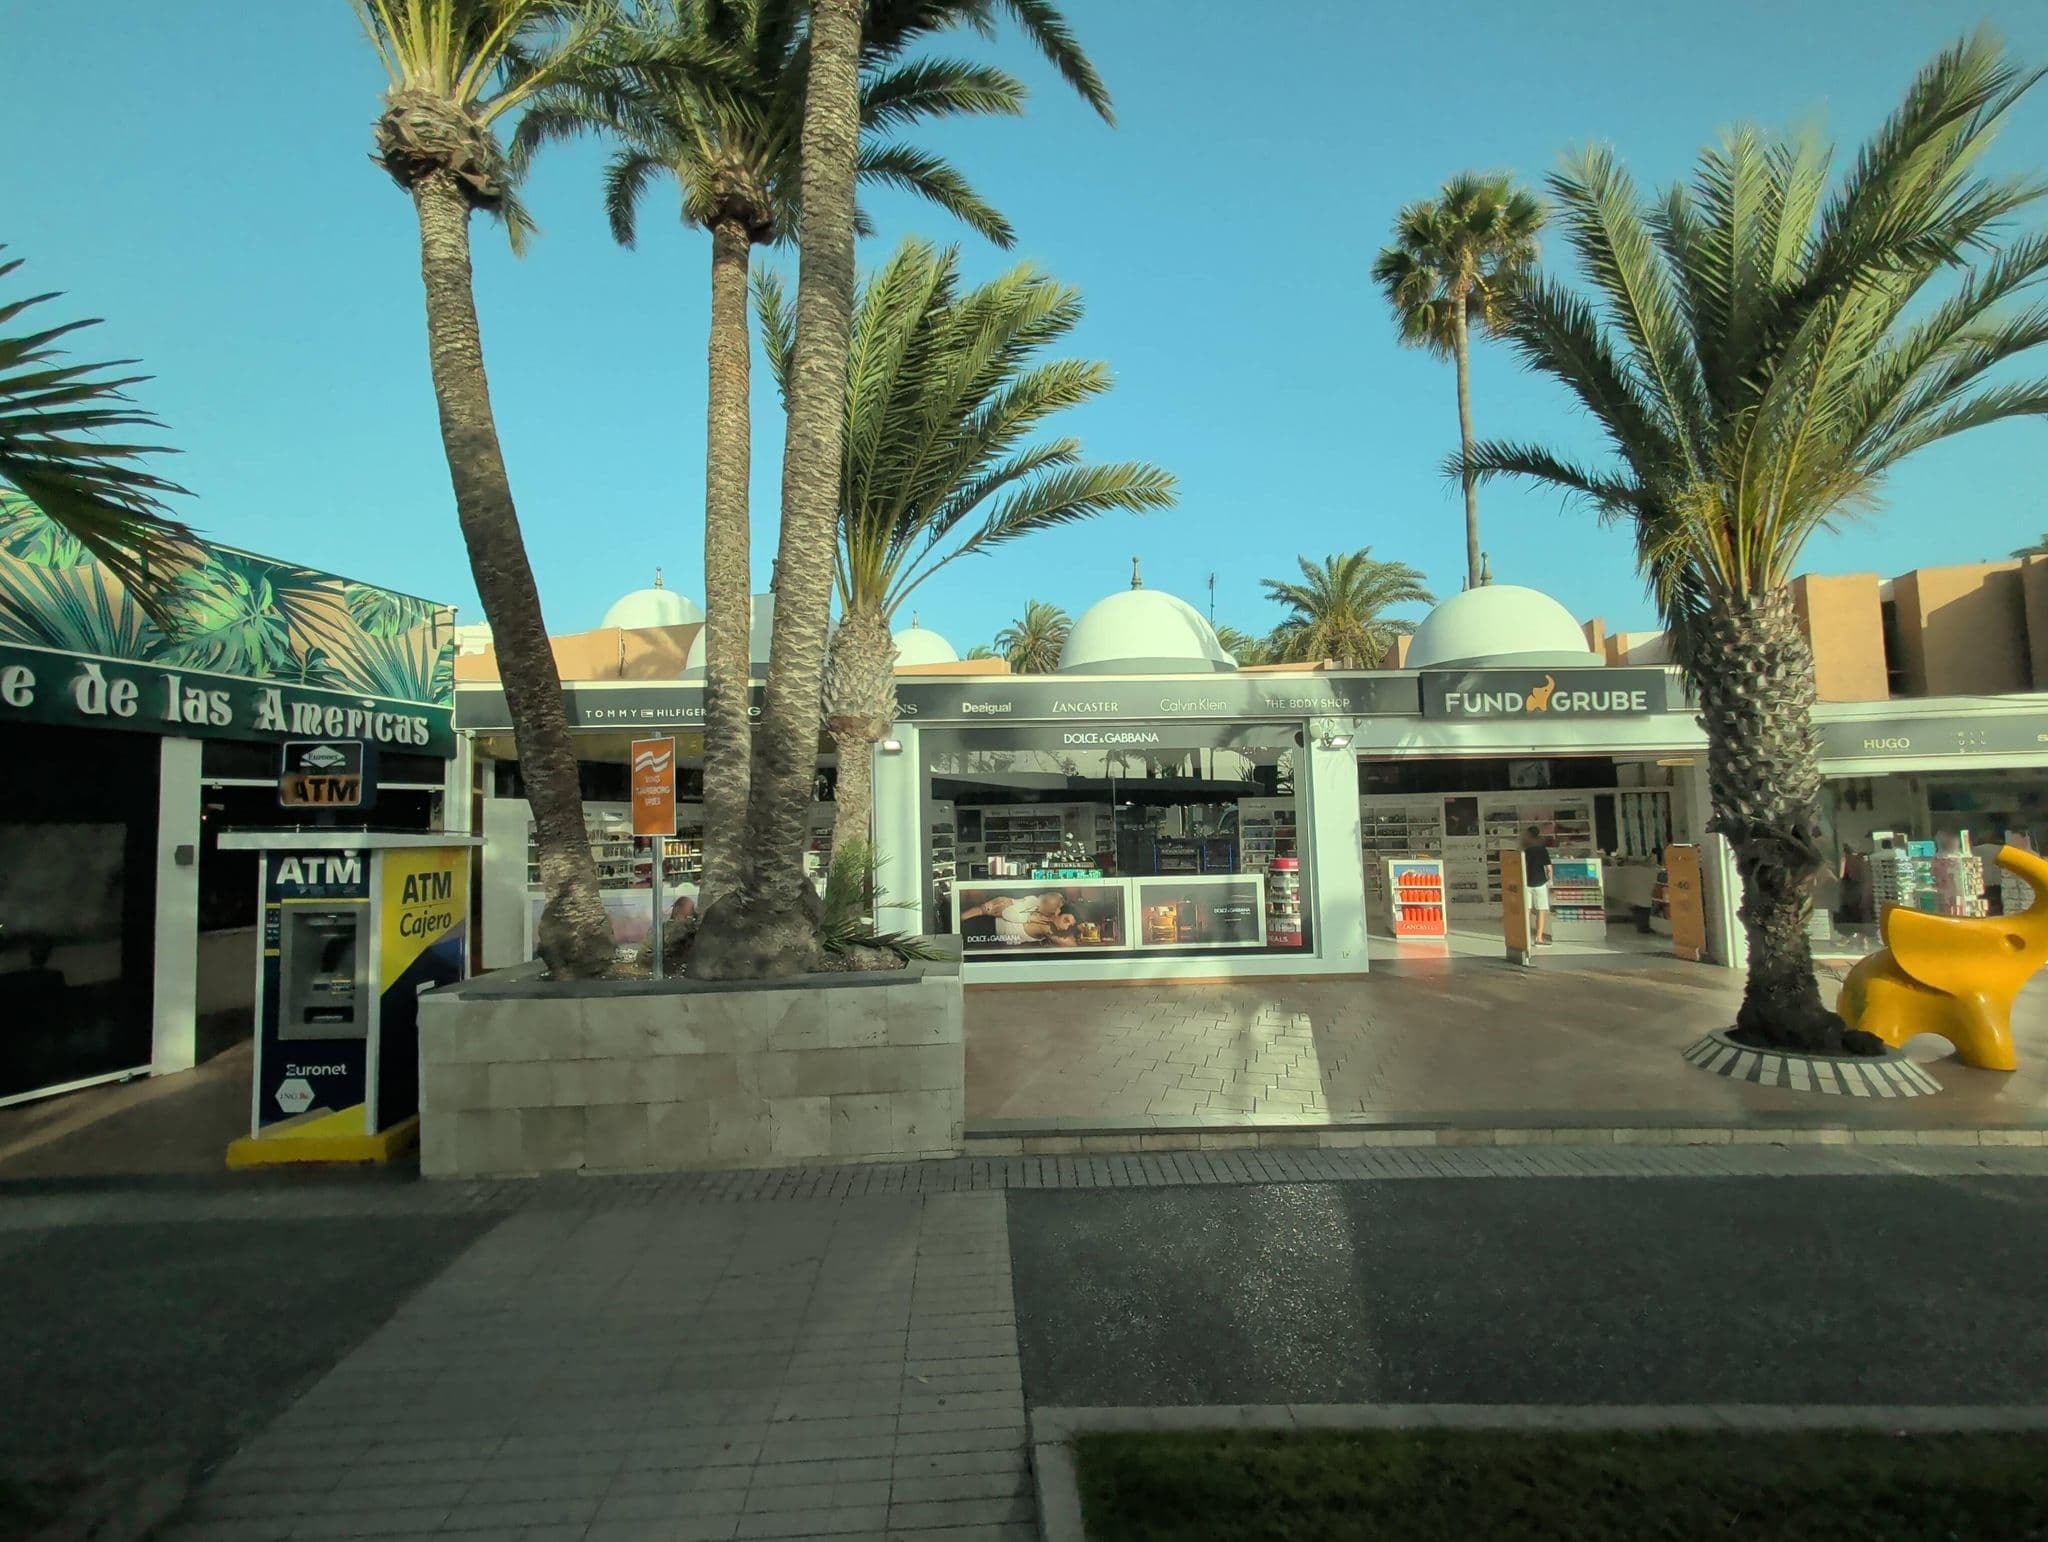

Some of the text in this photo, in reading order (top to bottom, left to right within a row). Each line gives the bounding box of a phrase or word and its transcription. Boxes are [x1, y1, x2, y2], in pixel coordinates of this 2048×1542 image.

[71, 661, 139, 717] de
[160, 673, 233, 726] las
[253, 687, 430, 746] Americas
[962, 702, 1012, 715] Desigual
[1052, 701, 1119, 713] LANCASTER
[1160, 698, 1227, 712] Calvin Klein
[1265, 698, 1350, 709] THE BODY SHOP
[1445, 691, 1648, 713] FUND GRUBE
[585, 708, 707, 719] TOMMY HILFIGER
[1863, 737, 1910, 749] HUGO
[293, 778, 359, 802] ATM
[276, 856, 361, 884] ATM
[401, 871, 452, 904] ATM
[400, 910, 452, 938] Cajero
[286, 1064, 347, 1076] Euronet
